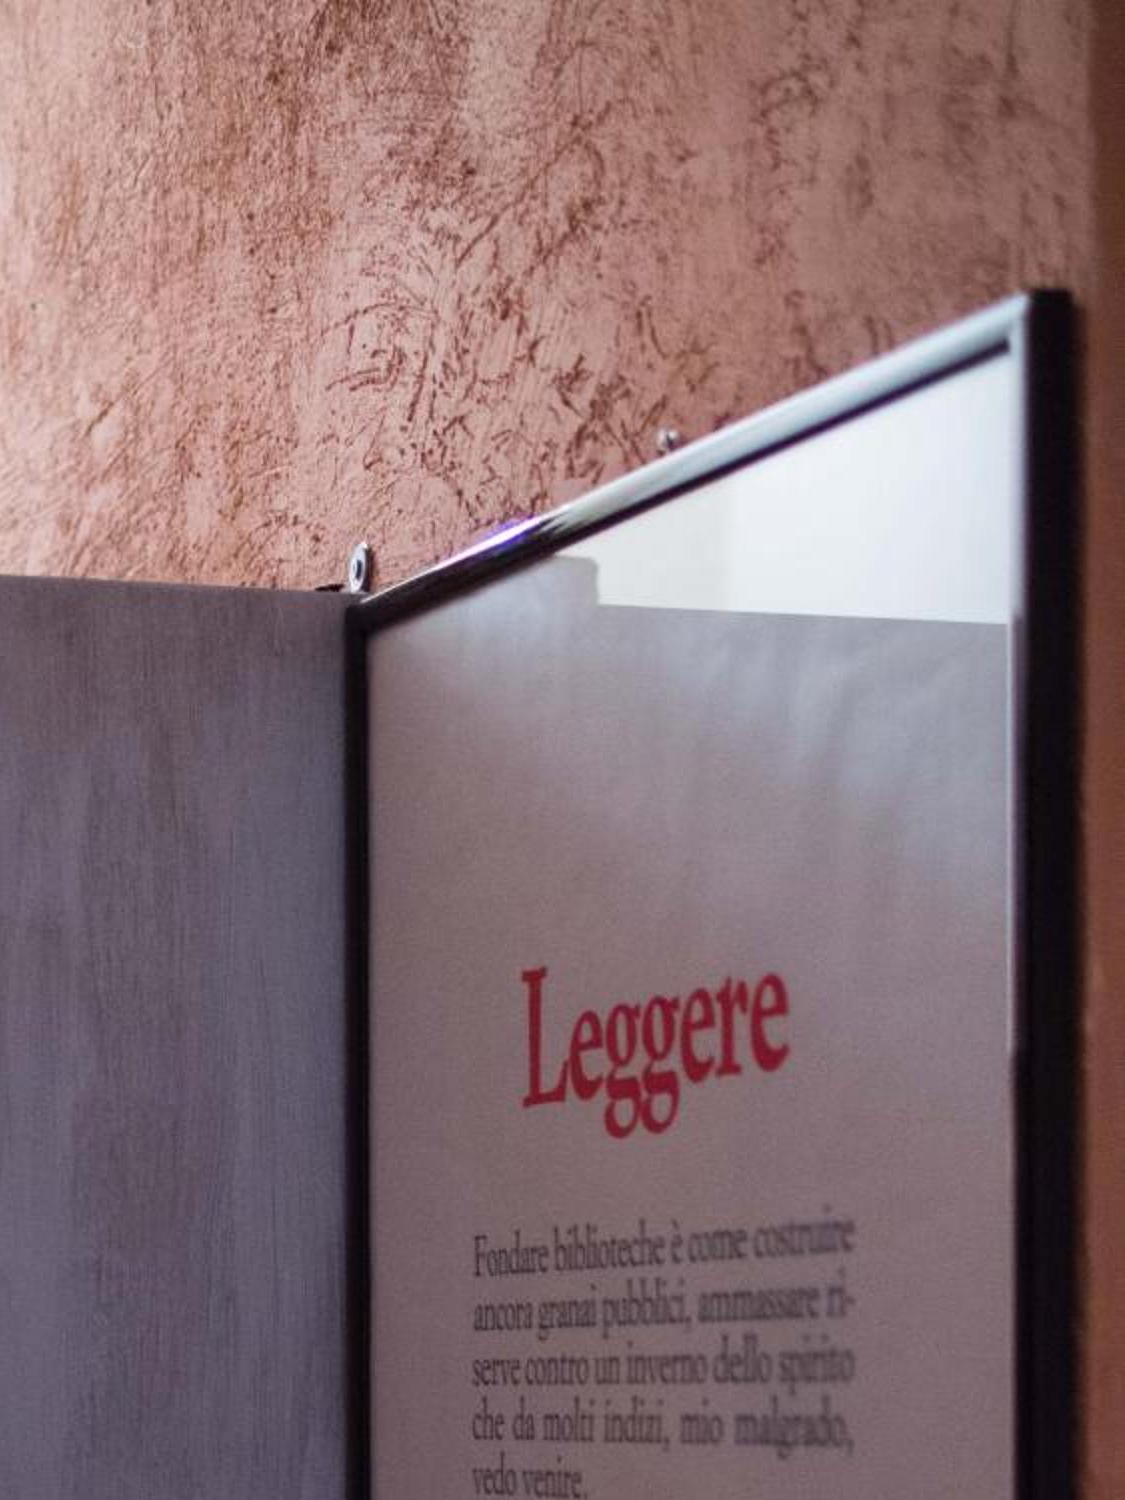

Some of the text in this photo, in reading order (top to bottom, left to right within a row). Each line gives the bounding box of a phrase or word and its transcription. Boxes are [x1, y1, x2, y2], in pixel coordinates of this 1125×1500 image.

[520, 966, 791, 1139] Leggere
[473, 1203, 855, 1277] Fondare biblioteche è come costruire
[473, 1266, 855, 1341] ancora granai pubblici, ammassare ri-
[472, 1332, 856, 1396] serve contro un inverno dello spirito
[472, 1394, 855, 1460] che da molti indizi, mio malgrado,
[472, 1450, 588, 1499] vedo venire.
